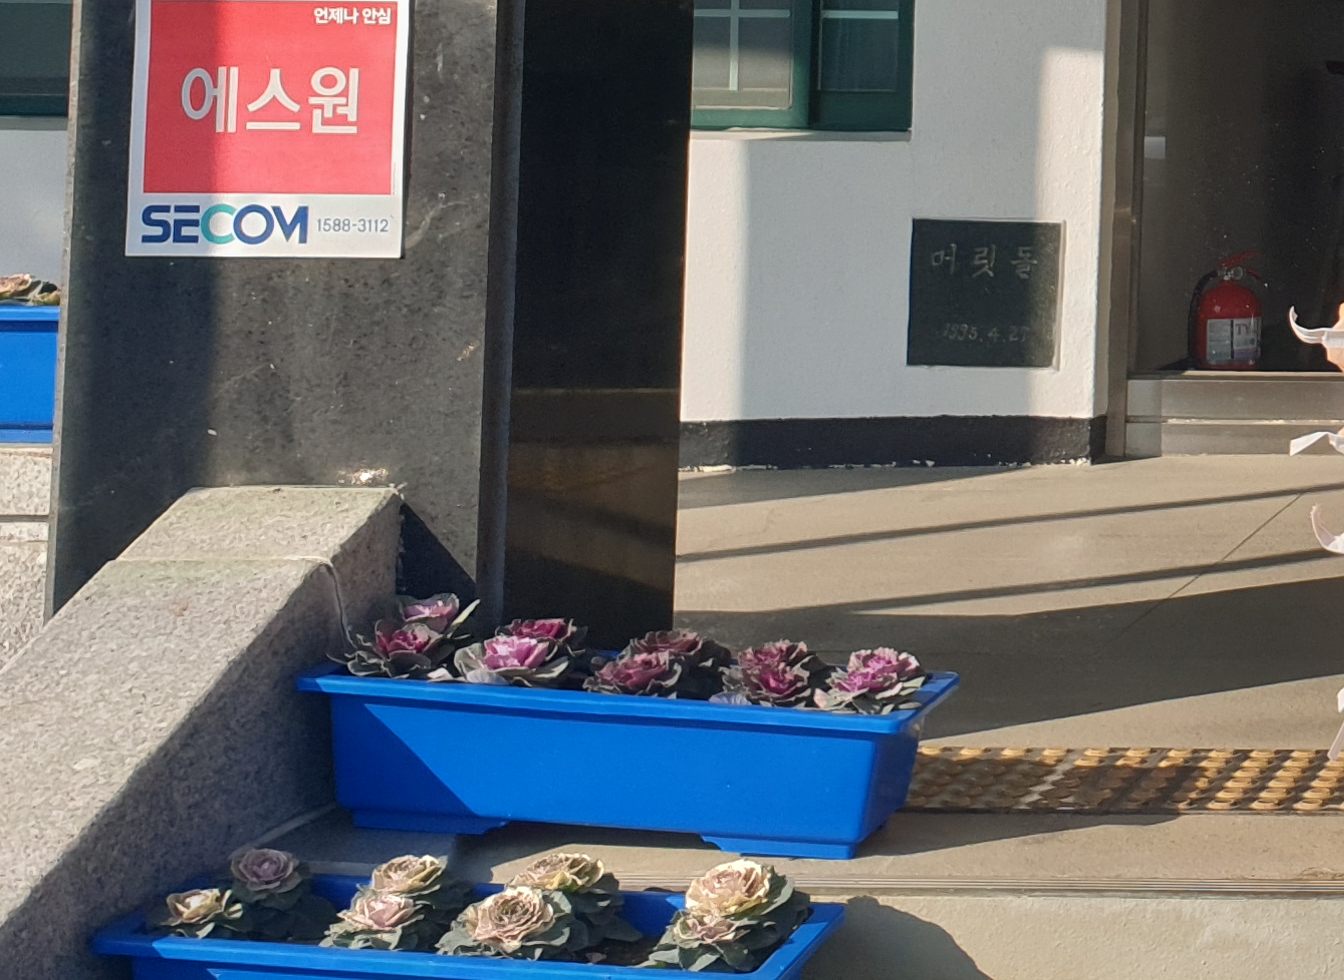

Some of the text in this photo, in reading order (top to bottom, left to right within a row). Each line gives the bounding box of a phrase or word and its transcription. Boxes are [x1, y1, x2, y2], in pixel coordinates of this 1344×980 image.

[314, 7, 392, 24] 언제나 안심
[180, 66, 360, 134] 에스원
[141, 203, 389, 245] SECOM 1588-3112
[931, 243, 1038, 279] 머릿돌
